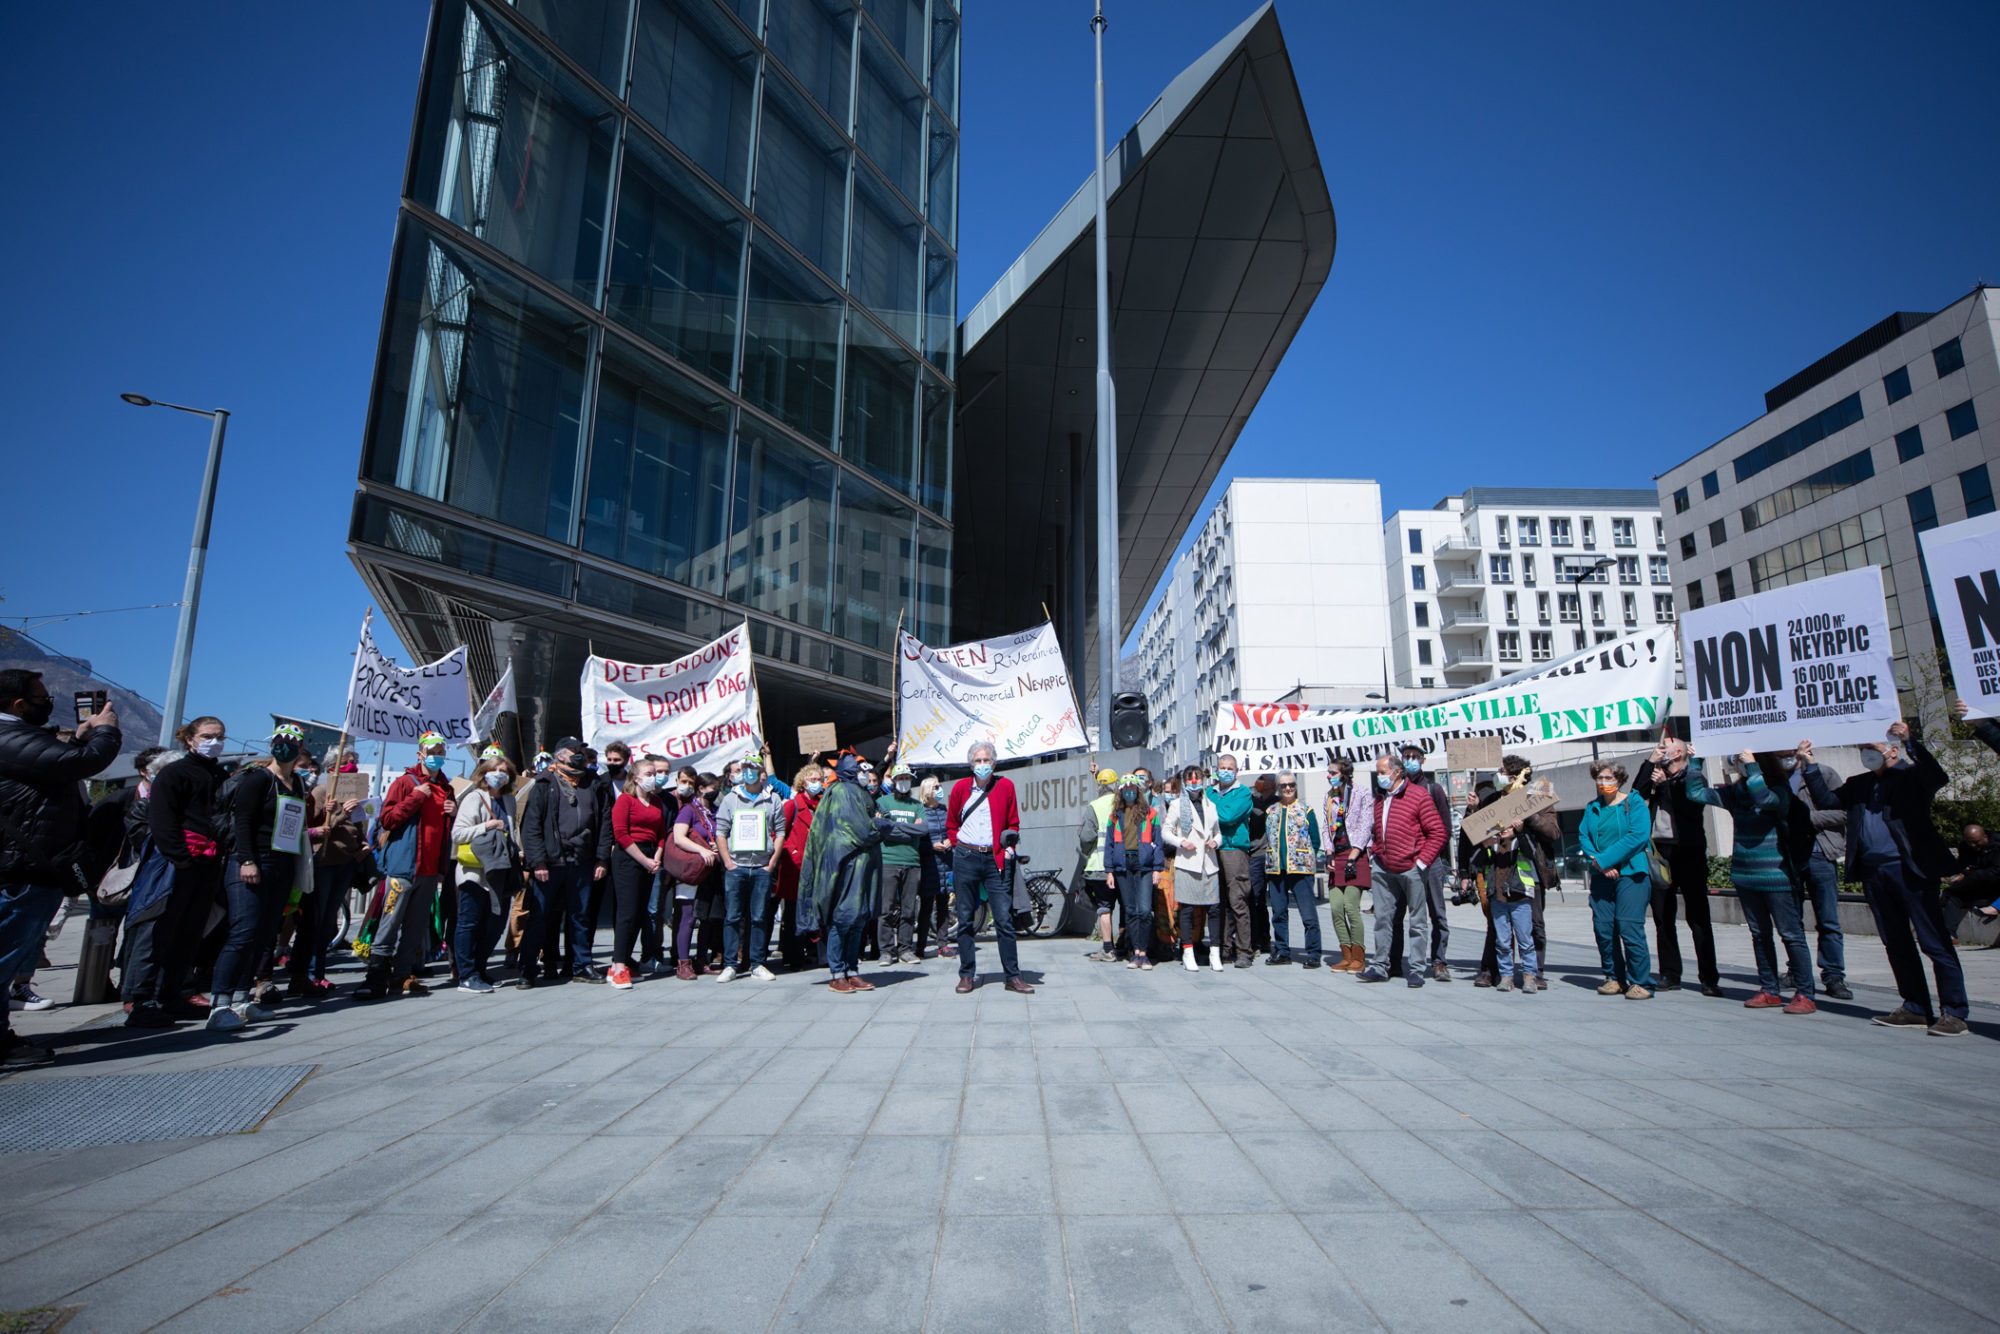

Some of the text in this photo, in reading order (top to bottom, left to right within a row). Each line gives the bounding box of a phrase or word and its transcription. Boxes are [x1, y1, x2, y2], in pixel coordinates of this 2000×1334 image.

[1787, 619, 1803, 637] 24
[1805, 613, 1830, 634] 000
[1014, 633, 1037, 645] aux
[1789, 624, 1870, 662] NEYRPIC
[604, 633, 739, 682] DEFENDONS
[1693, 624, 1782, 701] NON
[1973, 650, 1995, 664] AUX
[1792, 666, 1807, 684] 16
[1809, 662, 1835, 682] 000
[1976, 663, 1997, 678] DES
[901, 680, 943, 700] Centre
[951, 683, 1015, 703] Commercial
[1794, 675, 1879, 708] GD PLACE
[1979, 677, 2000, 696] DE
[606, 700, 632, 724] LE
[1230, 703, 1309, 730] NON
[1539, 696, 1659, 740] ENFIN
[1699, 695, 1777, 718] À LA CRÉATION DE
[1796, 702, 1864, 720] AGRANDISSEMENT
[899, 706, 947, 759] Albert
[1040, 707, 1076, 746] Solange
[1215, 734, 1268, 753] POUR
[1272, 731, 1295, 749] UN
[1300, 723, 1346, 745] VRAI
[1352, 693, 1541, 738] CENTRE-VILLE
[1700, 711, 1787, 731] SURFACES COMMERCIALES
[1005, 713, 1045, 755] Monica
[1021, 774, 1089, 812] JUSTICE
